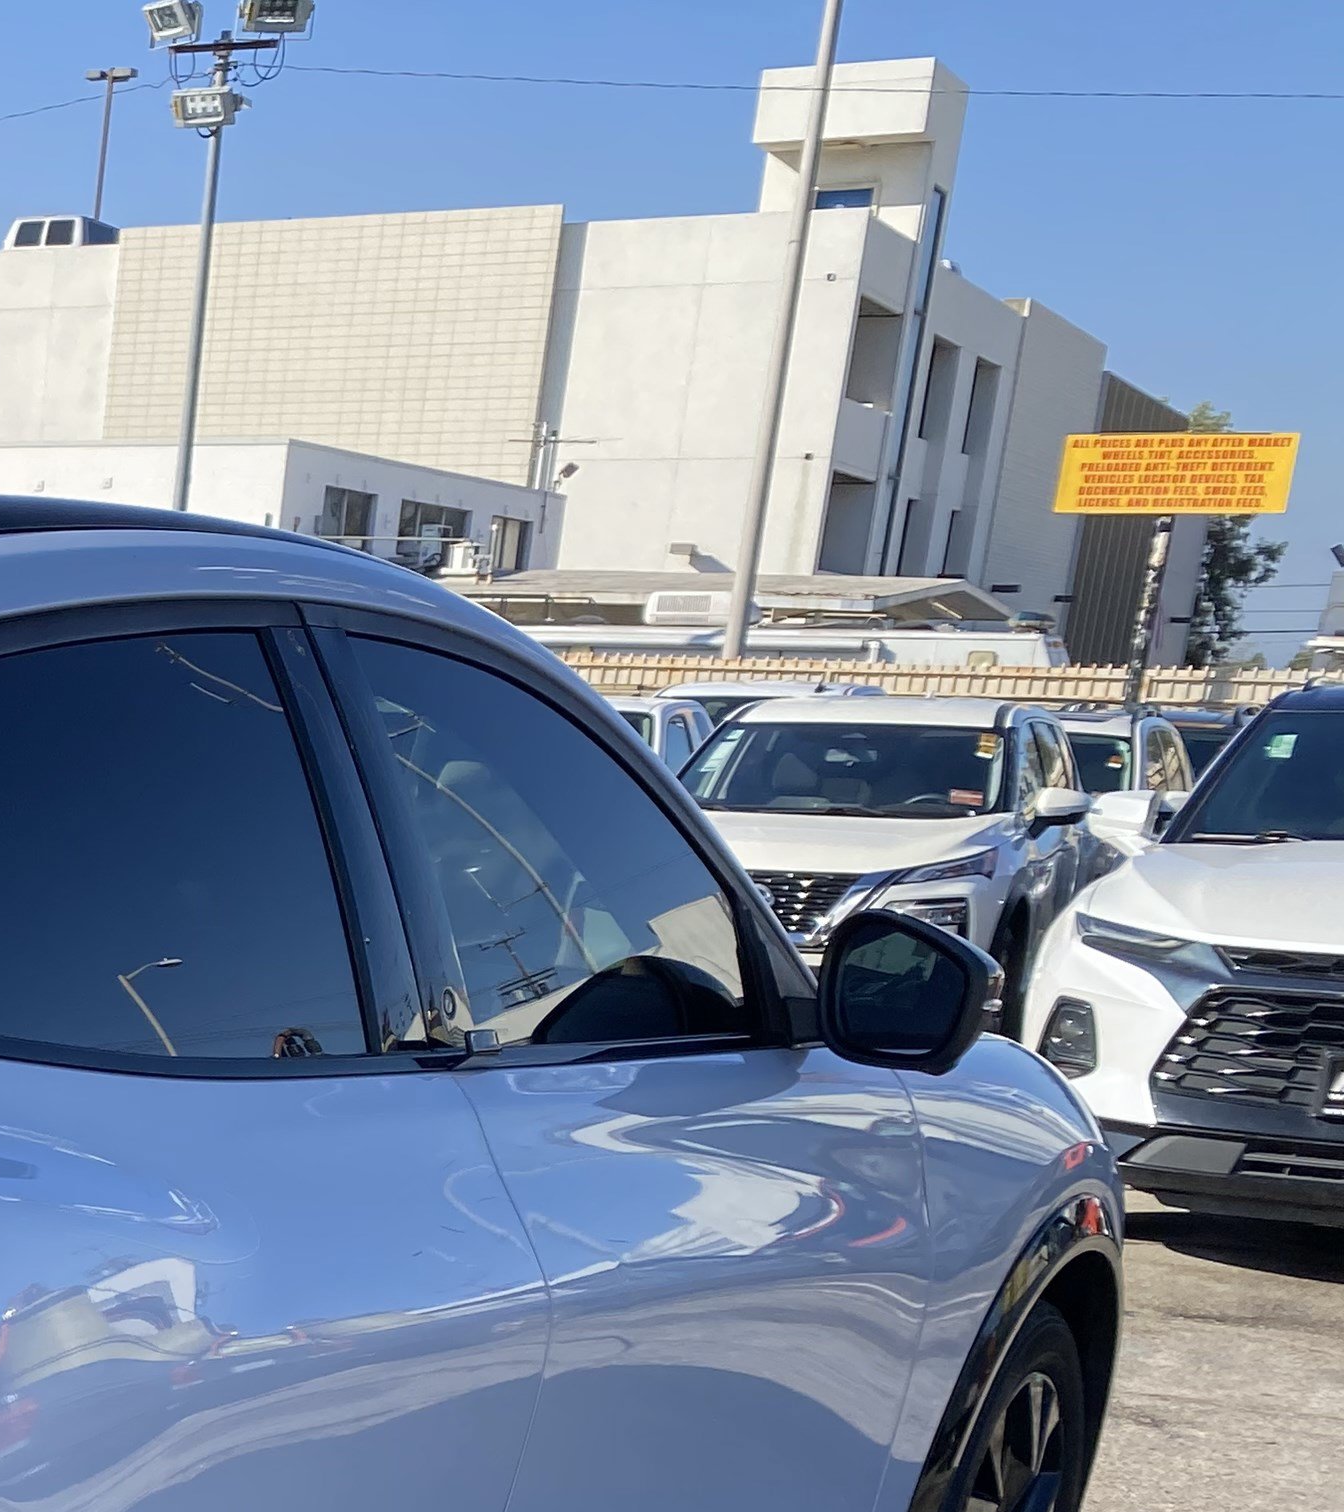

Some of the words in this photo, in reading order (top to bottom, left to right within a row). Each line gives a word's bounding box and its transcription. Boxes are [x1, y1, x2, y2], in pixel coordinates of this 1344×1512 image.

[1073, 439, 1089, 448] ALL
[1094, 439, 1132, 448] PRICES
[1134, 439, 1155, 448] ARE
[1157, 438, 1185, 448] PLUS
[1188, 438, 1210, 447] ANY
[1211, 438, 1245, 447] AFTER
[1247, 438, 1293, 447] MARKET
[1080, 463, 1142, 472] PRELOADED
[1144, 462, 1208, 472] ANTI-THEFT
[1084, 474, 1135, 484] VEHICLES
[1138, 474, 1187, 483] LOCATOR
[1078, 486, 1170, 496] DOCUMENTATION
[1204, 486, 1237, 495] SMOG
[1127, 498, 1149, 507] AND
[1152, 498, 1232, 507] REGISTRATION
